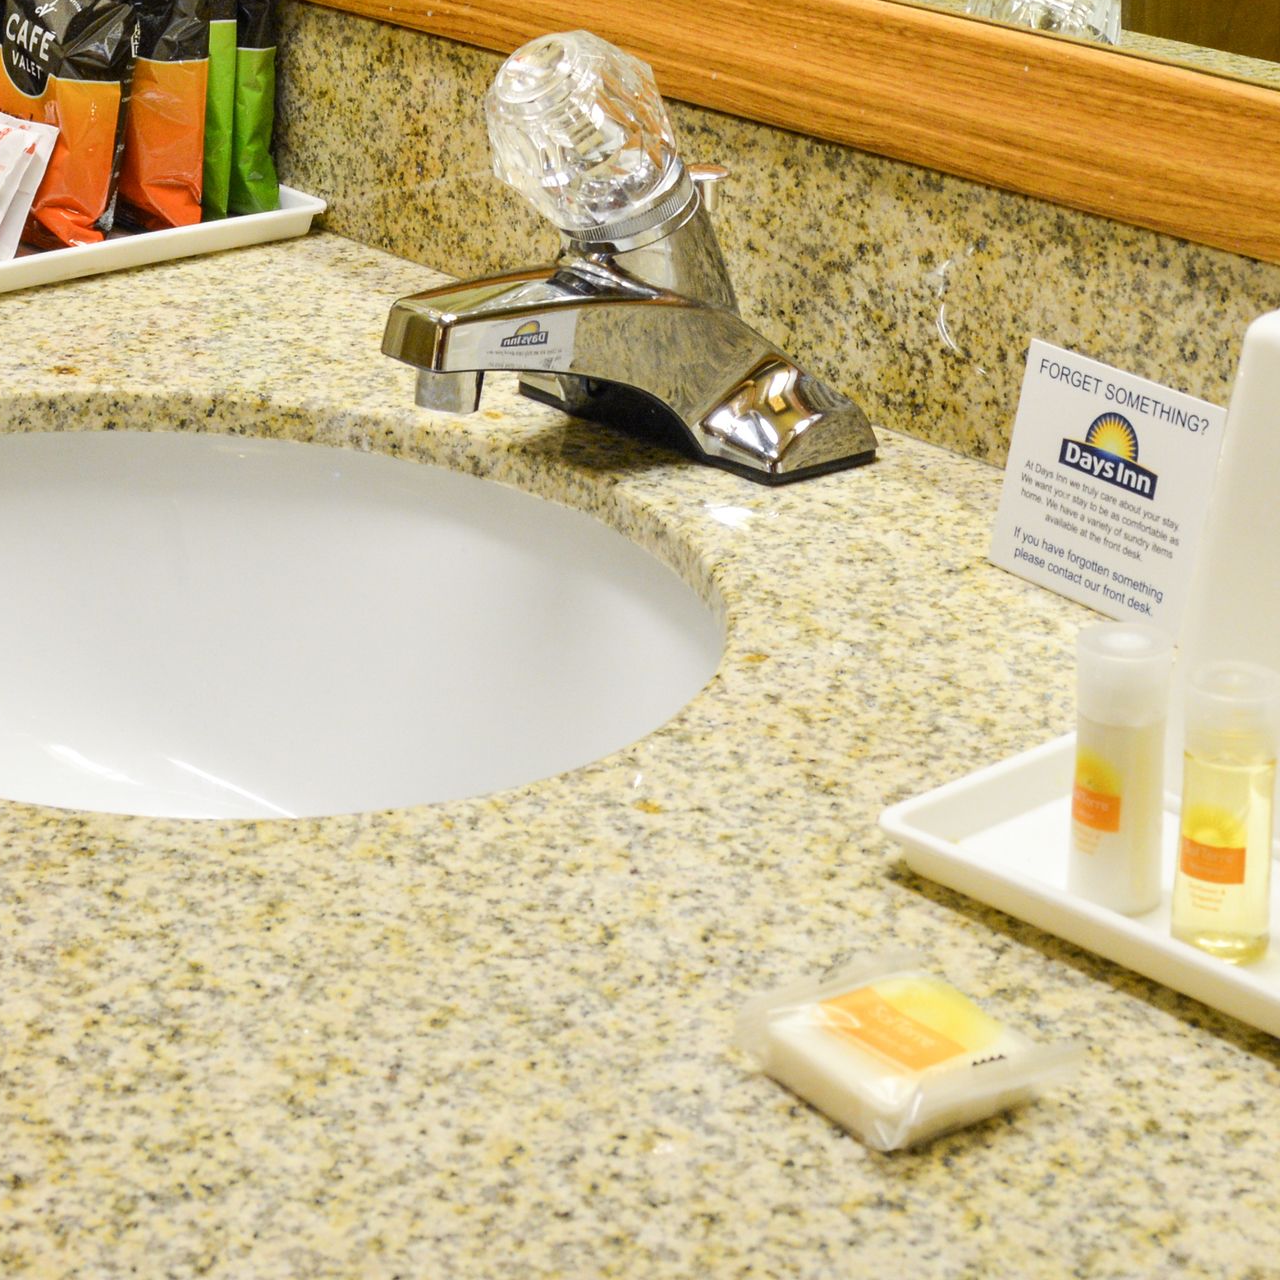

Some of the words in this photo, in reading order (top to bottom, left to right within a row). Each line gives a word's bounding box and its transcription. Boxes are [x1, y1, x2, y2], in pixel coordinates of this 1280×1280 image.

[6, 13, 56, 62] CAFÉ
[12, 49, 44, 80] VALET
[1039, 358, 1103, 395] FORGET
[1104, 383, 1210, 436] SOMETHING?
[1025, 460, 1034, 471] At
[1035, 463, 1054, 479] Days
[1056, 472, 1068, 484] Inn
[1069, 480, 1080, 490] we
[1082, 483, 1099, 499] truly
[1100, 492, 1117, 505] care
[1119, 500, 1141, 515] about
[1142, 510, 1161, 522] your
[1065, 442, 1113, 478] Days
[1116, 463, 1152, 494] Inn
[1021, 472, 1033, 485] We
[1034, 480, 1052, 493] want
[1053, 488, 1071, 500] your
[1072, 495, 1088, 510] stay
[1089, 502, 1097, 512] to
[1099, 505, 1109, 516] be
[1110, 512, 1120, 522] as
[1121, 516, 1168, 541] comfortable
[1169, 536, 1180, 546] as
[1045, 513, 1078, 534] available
[1079, 528, 1088, 538] at
[1089, 531, 1101, 544] the
[1103, 537, 1122, 553] front
[1046, 497, 1059, 510] We
[1059, 504, 1078, 519] have
[1079, 513, 1086, 521] a
[1087, 517, 1112, 535] variety
[1113, 527, 1122, 537] of
[1123, 532, 1150, 551] sundry
[1151, 542, 1173, 559] items
[1013, 526, 1022, 538] If
[1021, 532, 1040, 547] you
[1041, 538, 1065, 558] have
[1067, 549, 1110, 577] forgotten
[1112, 571, 1164, 604] something
[1014, 547, 1046, 568] please
[1047, 562, 1083, 586] contact
[1084, 579, 1102, 592] our
[1102, 584, 1126, 604] front
[1127, 596, 1153, 616] desk.
